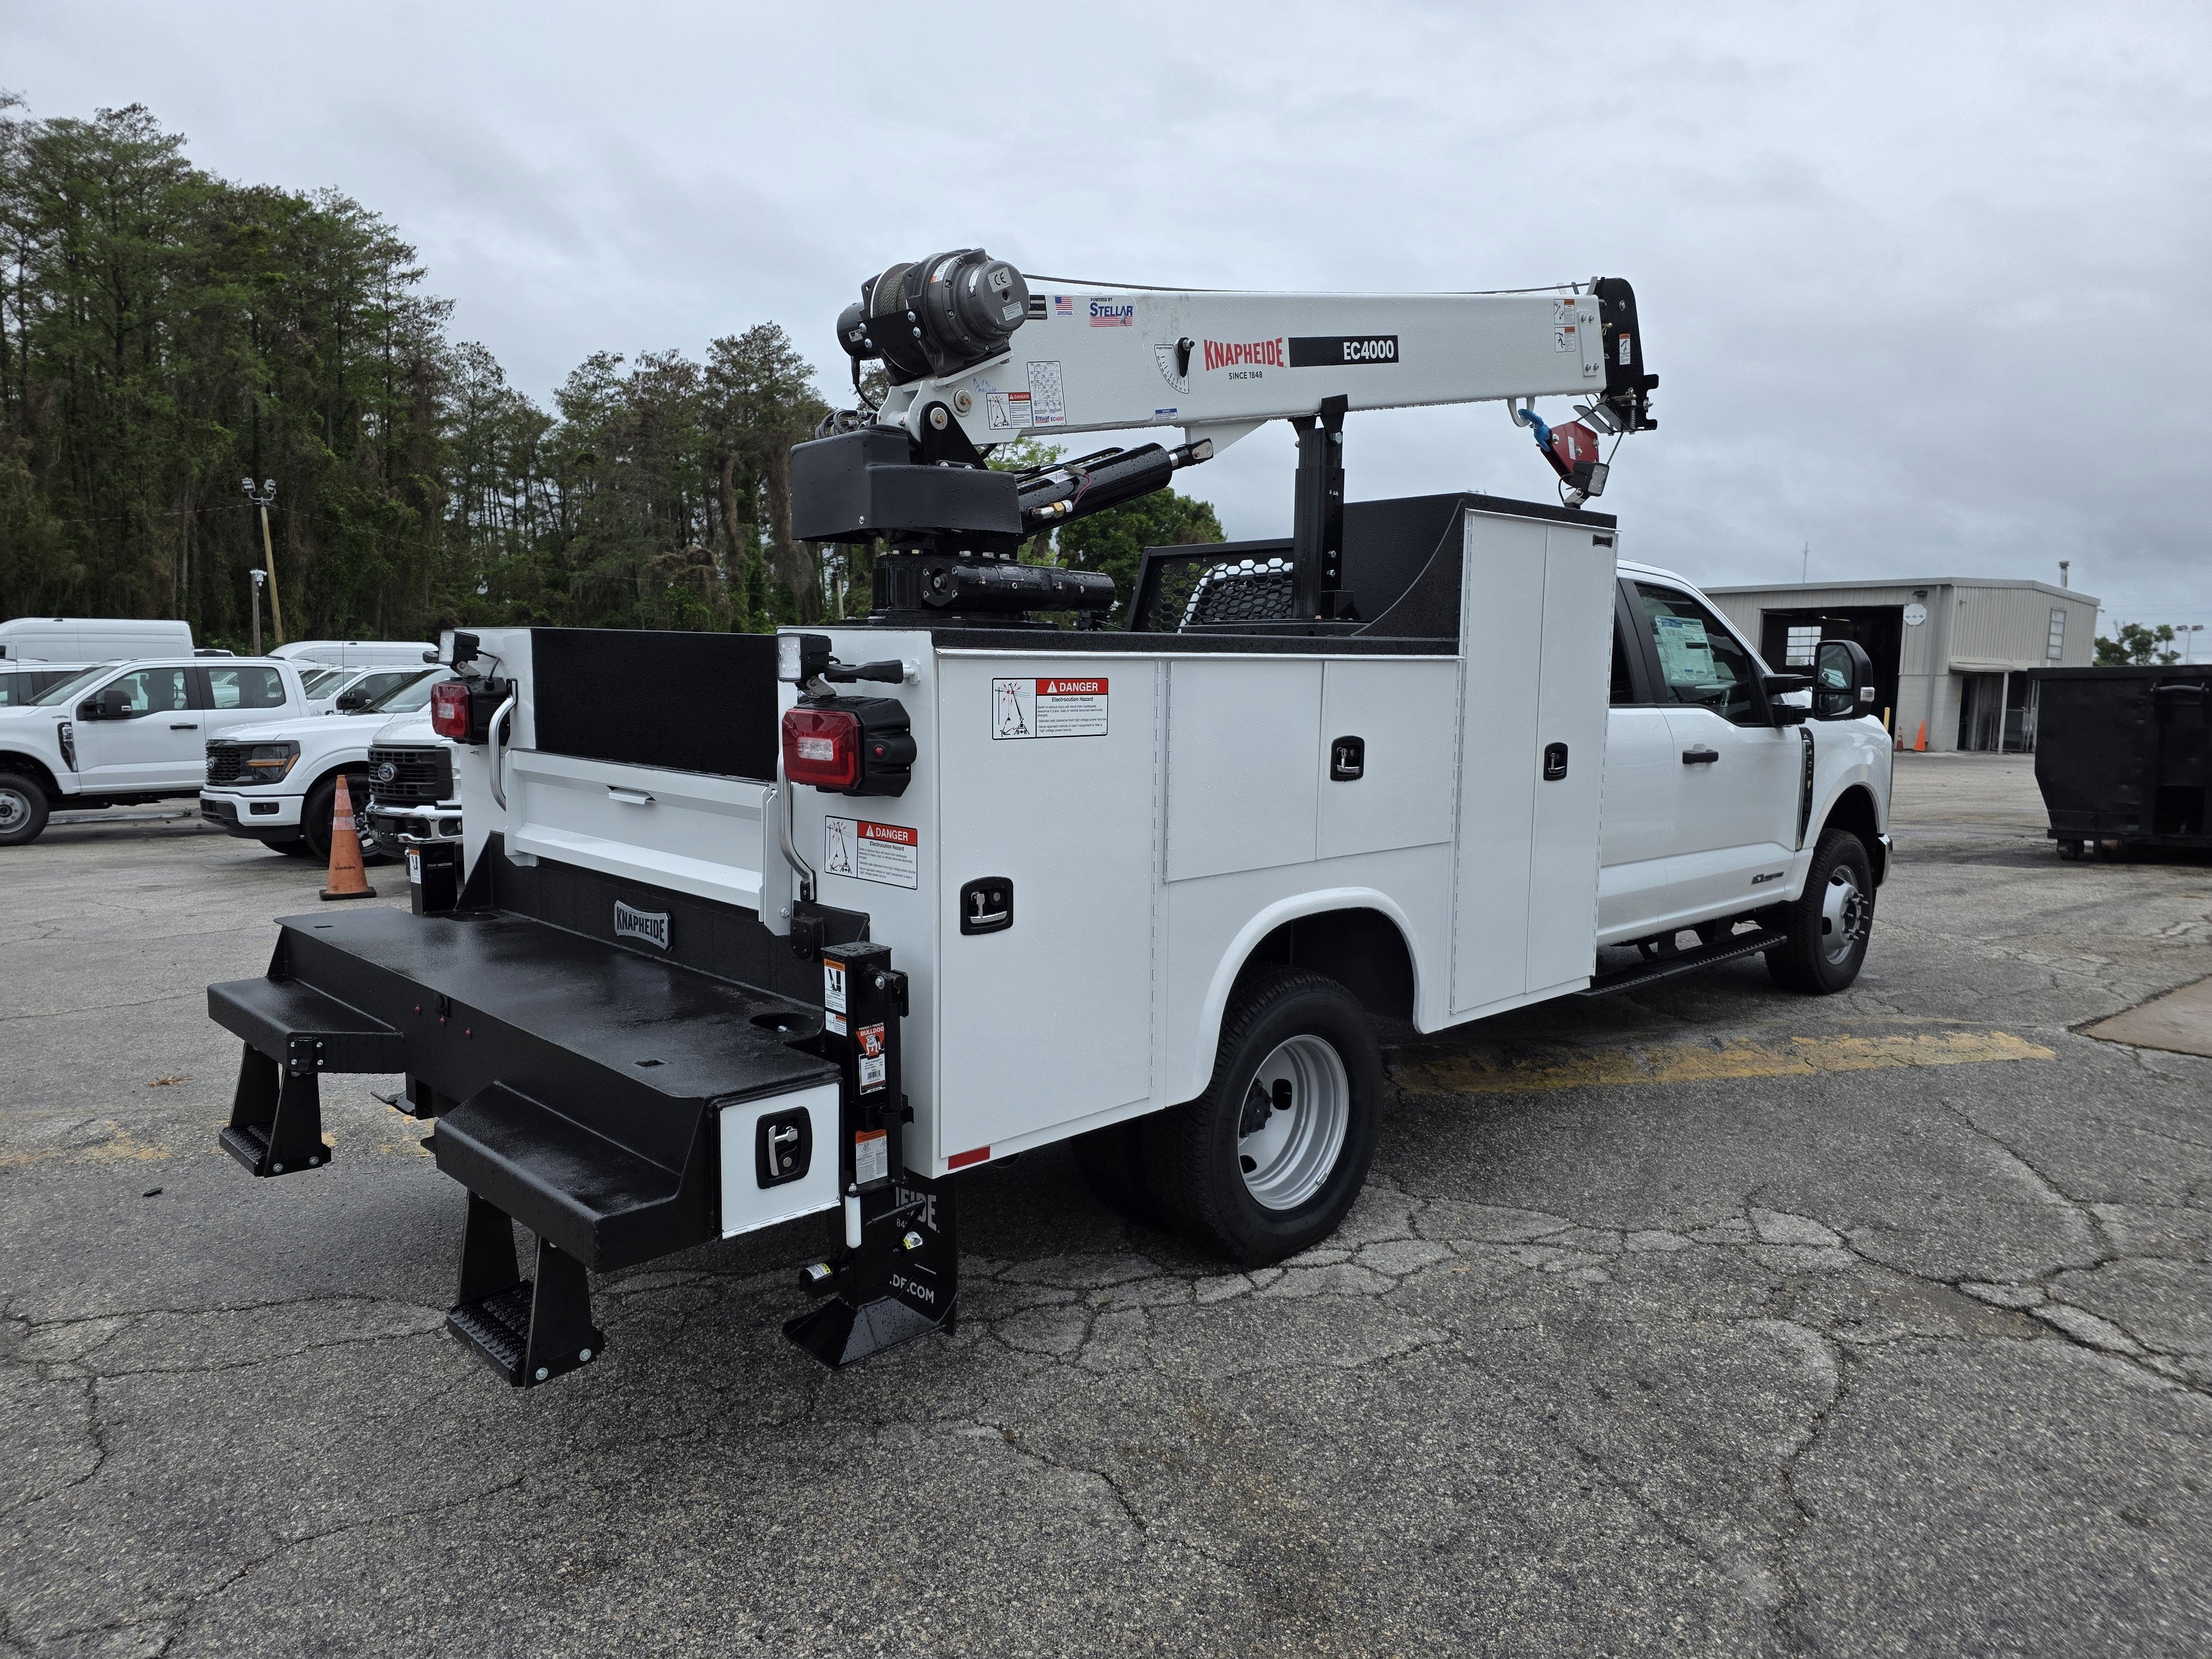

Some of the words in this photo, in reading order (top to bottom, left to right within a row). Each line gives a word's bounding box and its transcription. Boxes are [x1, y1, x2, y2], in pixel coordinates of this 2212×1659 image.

[1089, 302, 1133, 317] STELLAR
[1203, 337, 1285, 371] KNAPHEIDE
[1343, 340, 1394, 360] EC4000
[1228, 371, 1248, 380] SINCE
[1249, 371, 1262, 379] 1848
[1060, 682, 1098, 692] DANGER
[876, 827, 908, 841] DANGER
[617, 906, 665, 943] KNAPHEIDE
[860, 1026, 884, 1037] BULLDOG
